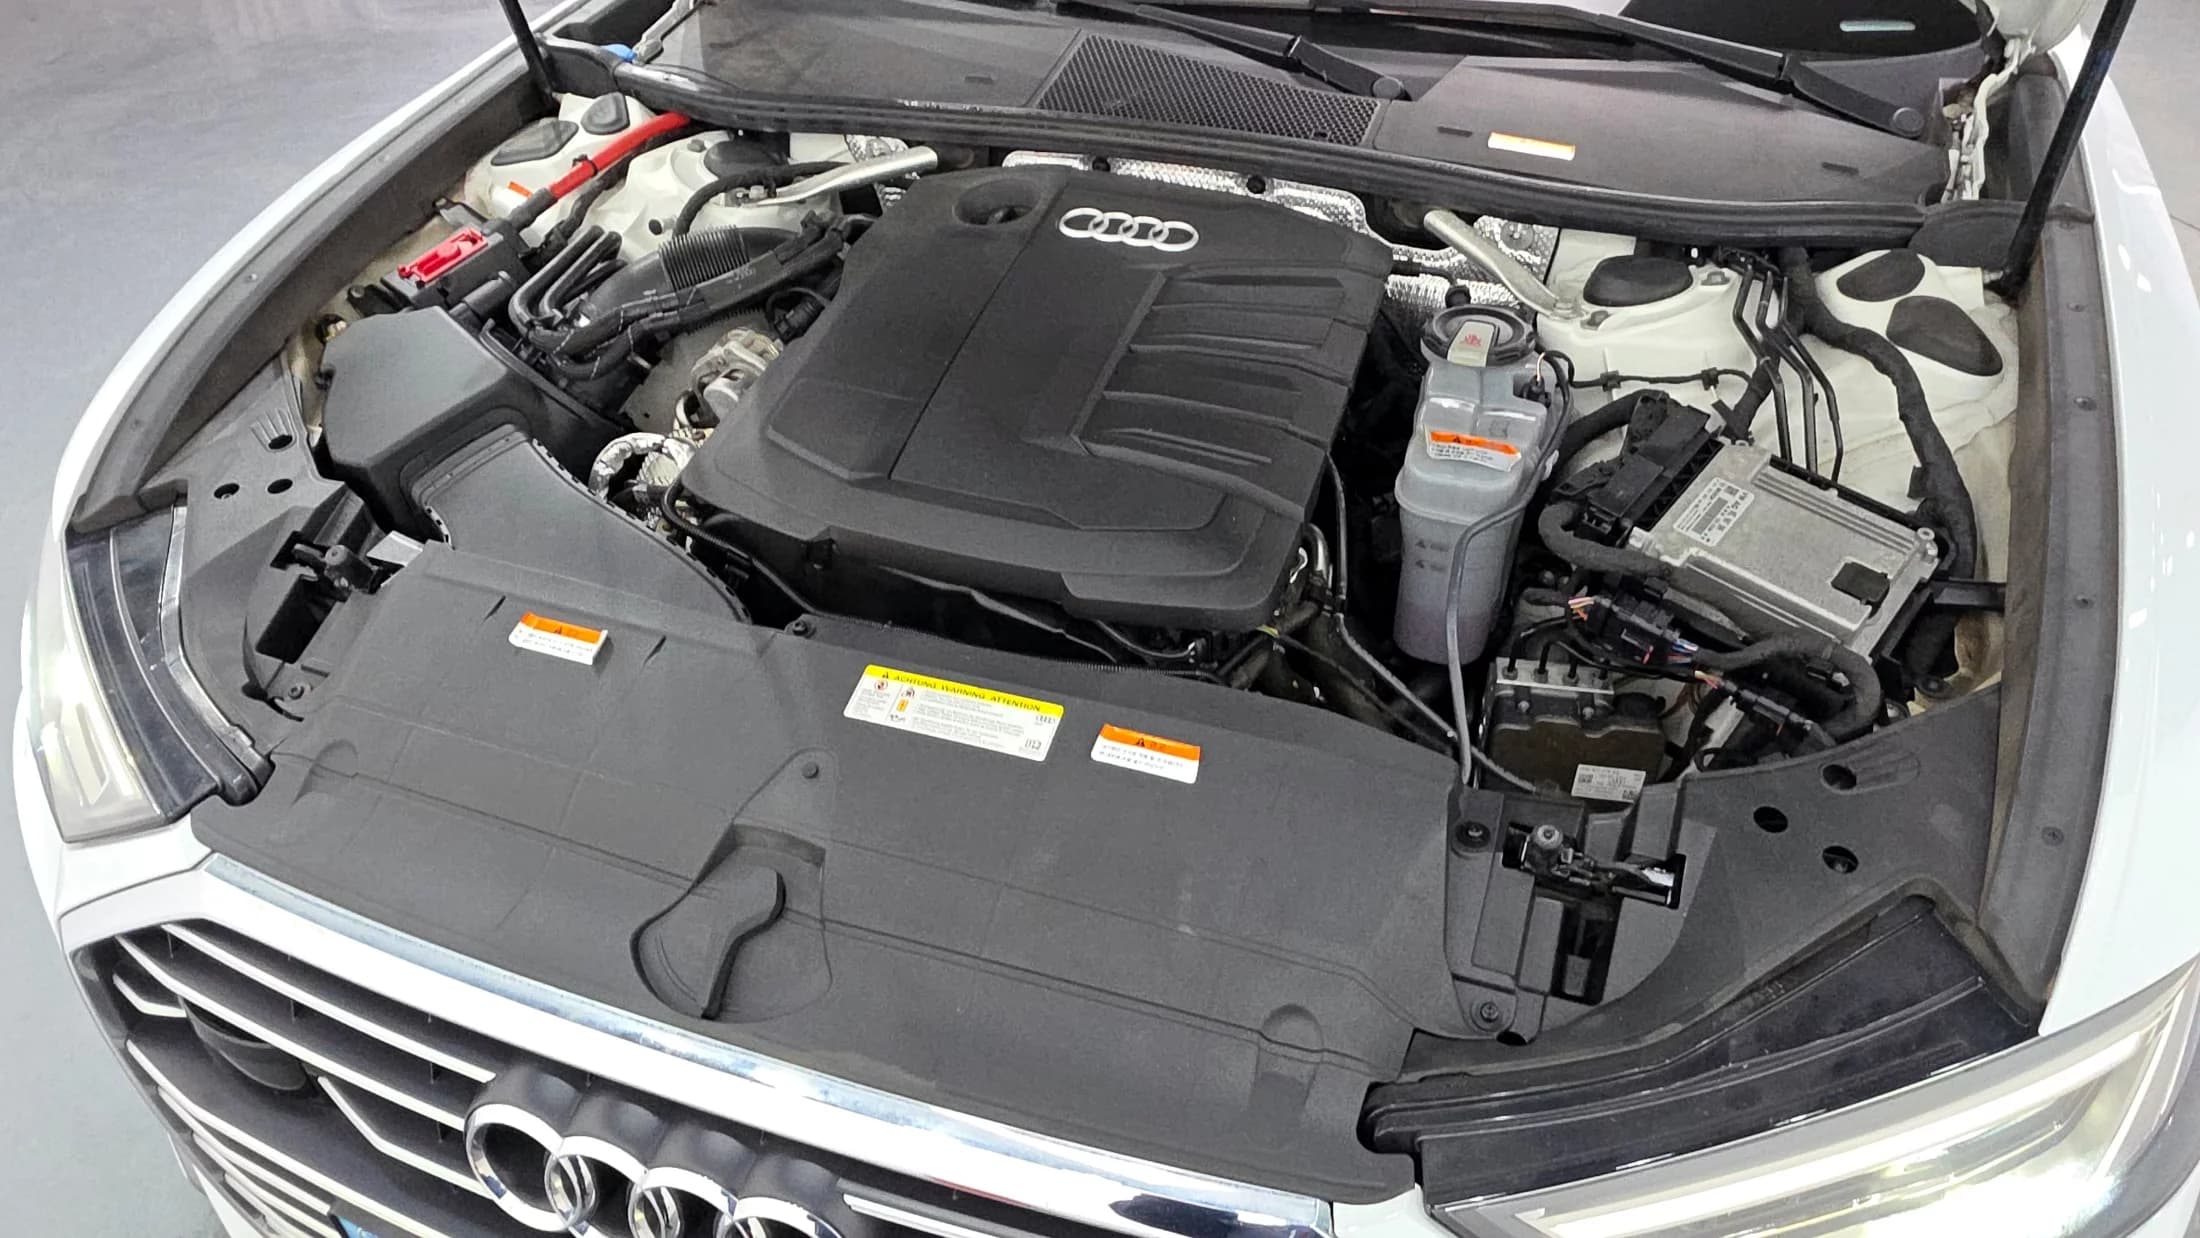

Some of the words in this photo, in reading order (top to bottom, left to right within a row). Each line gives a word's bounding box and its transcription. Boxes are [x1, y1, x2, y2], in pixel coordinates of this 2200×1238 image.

[893, 675, 937, 689] ACHTUNG
[941, 684, 985, 700] WARNING
[990, 695, 1041, 712] ATTENTION
